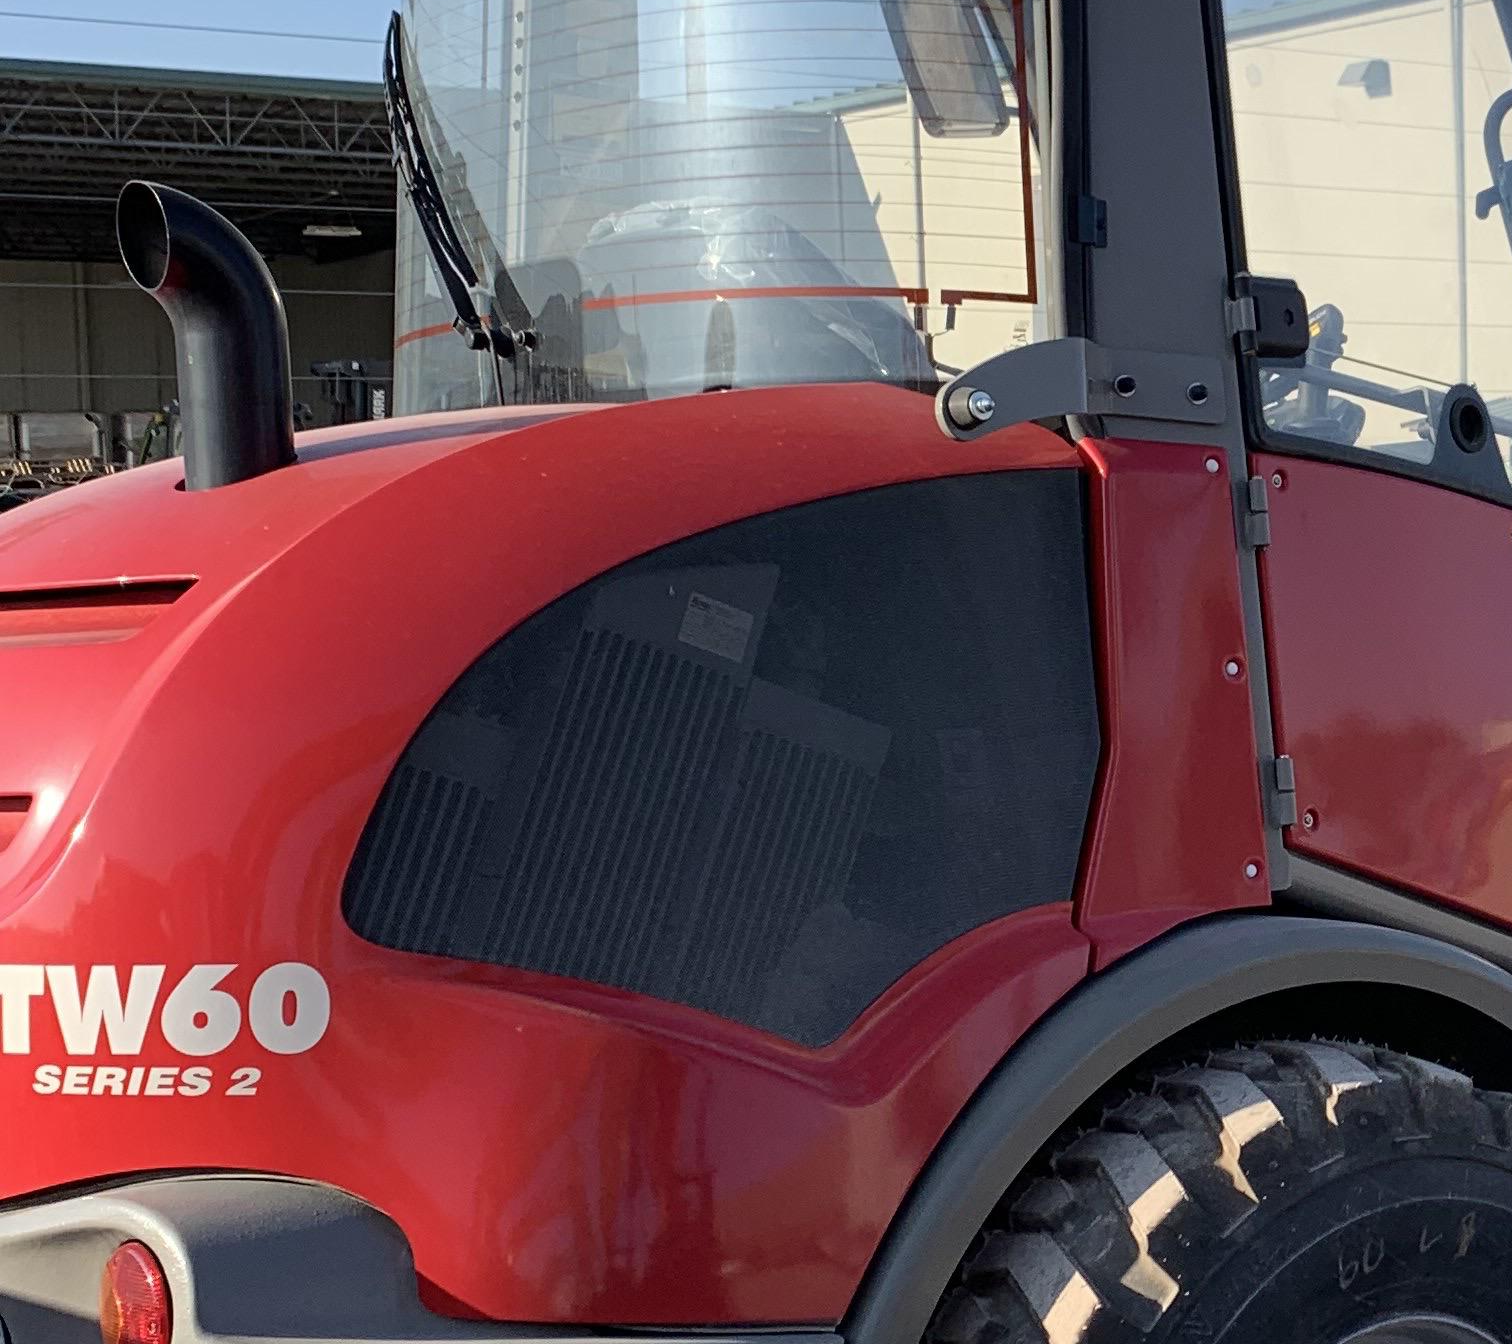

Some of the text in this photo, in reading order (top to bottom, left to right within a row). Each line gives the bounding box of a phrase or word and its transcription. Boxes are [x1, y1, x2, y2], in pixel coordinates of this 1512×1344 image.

[0, 962, 331, 1056] TW60
[32, 1065, 262, 1097] SERIES 2
